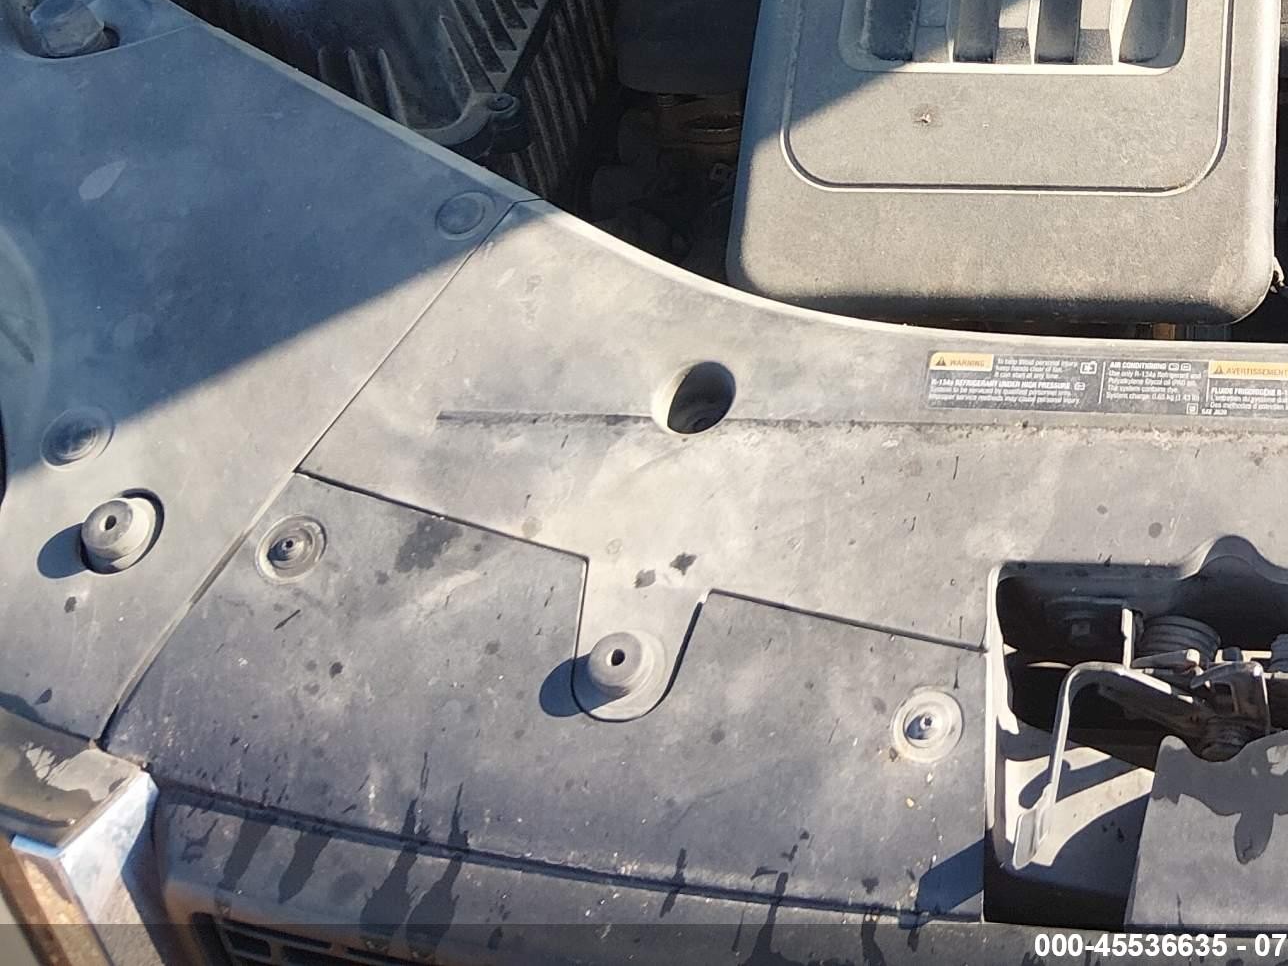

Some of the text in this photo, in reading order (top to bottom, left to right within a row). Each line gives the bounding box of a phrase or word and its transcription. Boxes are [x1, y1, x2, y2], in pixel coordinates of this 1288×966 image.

[950, 359, 985, 367] WARNING
[1122, 362, 1166, 370] CONDITIONING
[1226, 367, 1288, 376] AVERTISSEMENT
[931, 378, 1071, 390] R-134a REFRIGERANT UNDER HIGH PRESSURE
[1211, 387, 1233, 395] FLUIDE
